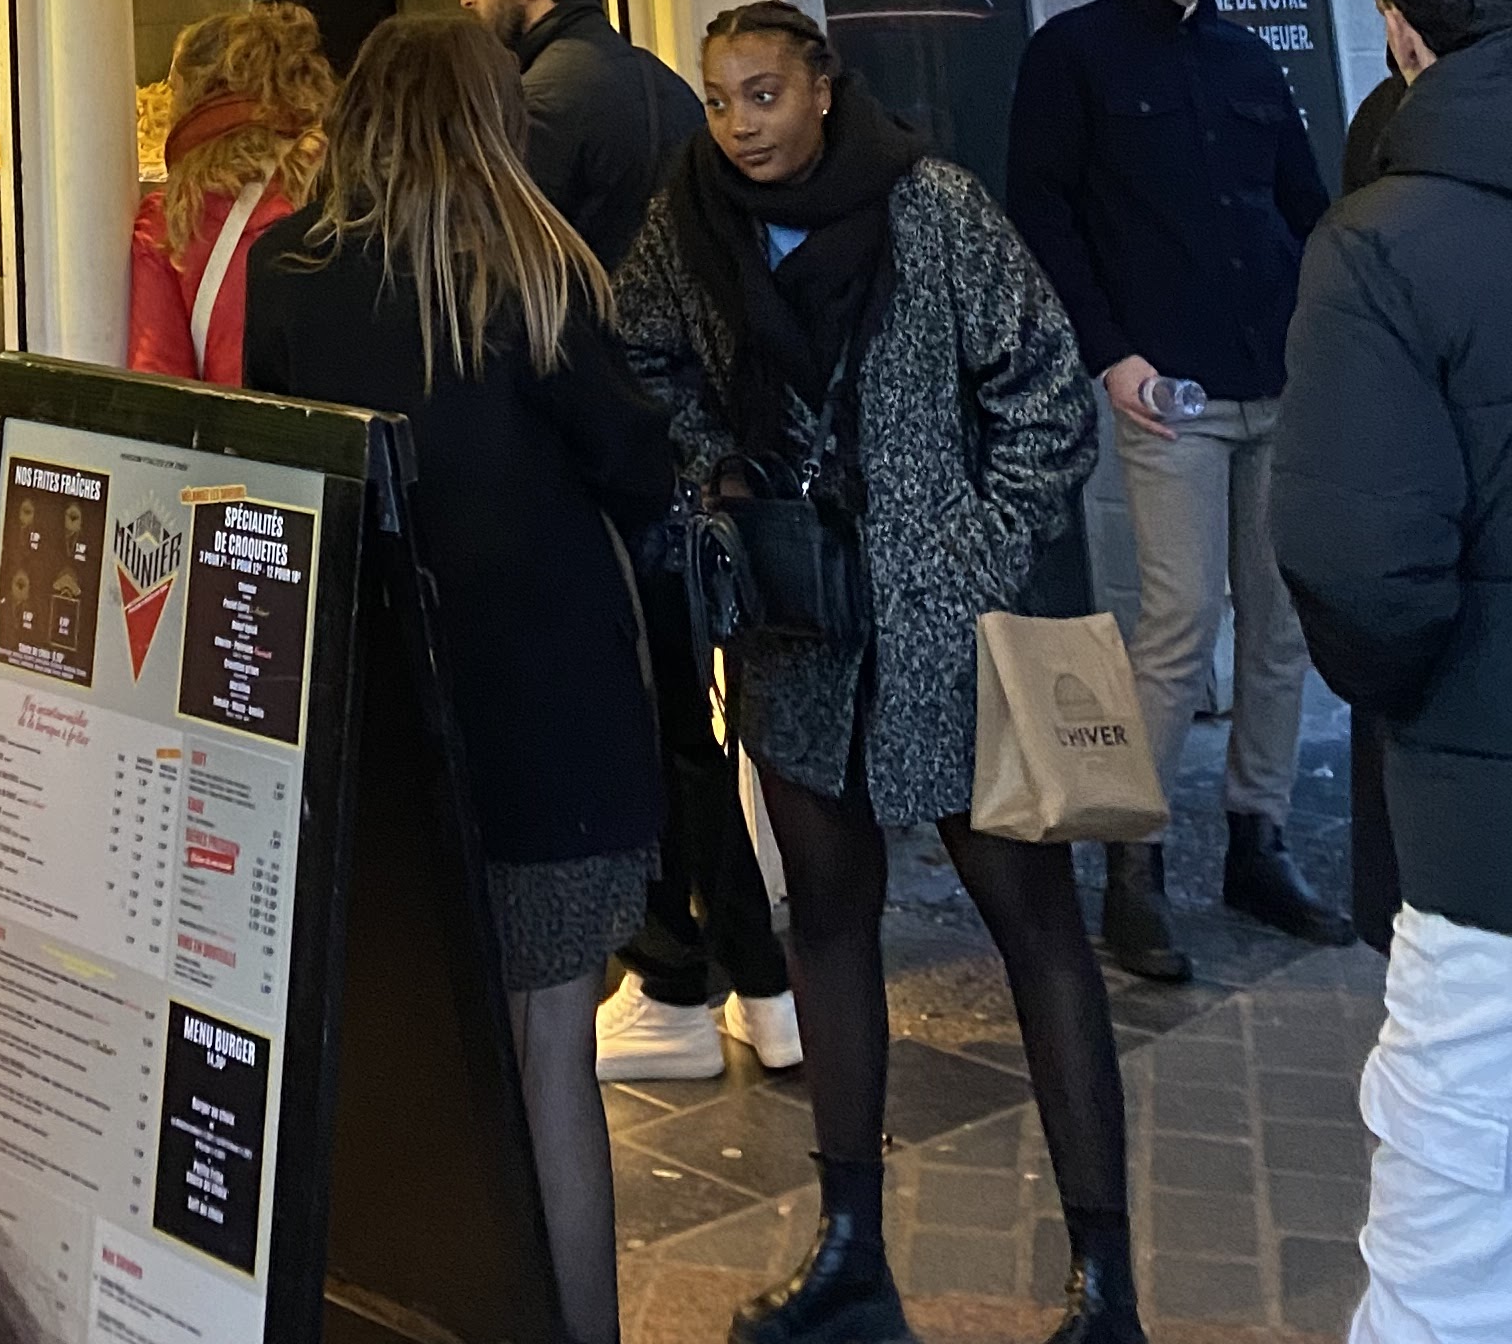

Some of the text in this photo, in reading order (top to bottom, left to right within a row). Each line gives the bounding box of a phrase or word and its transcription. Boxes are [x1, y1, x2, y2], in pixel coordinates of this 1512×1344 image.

[14, 465, 32, 487] NOS
[32, 469, 60, 492] FRITES
[225, 503, 284, 538] SPÉCIALITÉS
[114, 517, 182, 589] MEUNIER
[214, 530, 288, 566] DE CROQUETTES
[183, 1015, 214, 1049] MENU
[214, 1027, 256, 1068] BURGER
